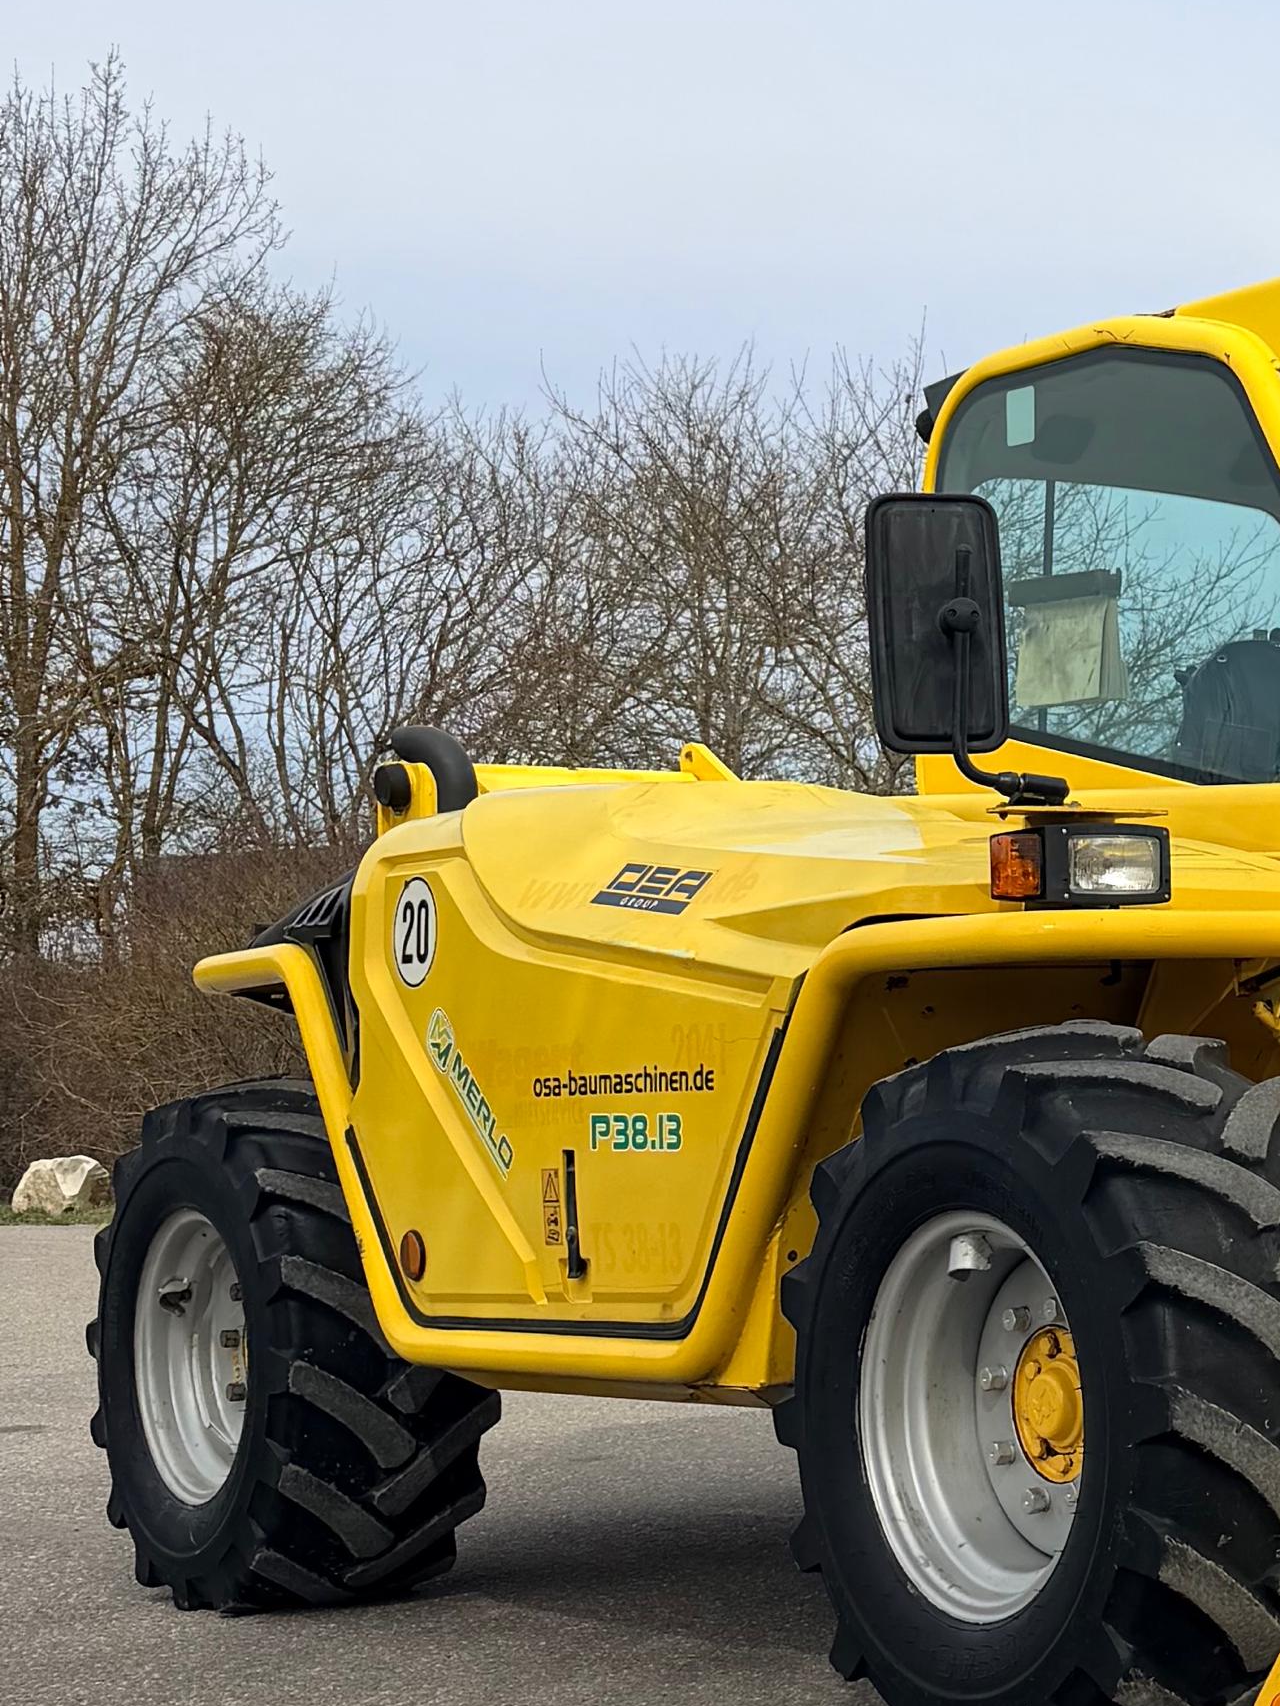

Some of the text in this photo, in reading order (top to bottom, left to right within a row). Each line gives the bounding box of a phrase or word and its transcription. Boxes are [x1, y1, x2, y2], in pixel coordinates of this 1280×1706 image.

[606, 862, 713, 900] OSA
[619, 896, 659, 909] GROUP
[401, 899, 430, 964] 20
[533, 1063, 715, 1099] osa-baumaschinen.de
[451, 1050, 513, 1171] MERLO
[590, 1113, 682, 1152] P38.13
